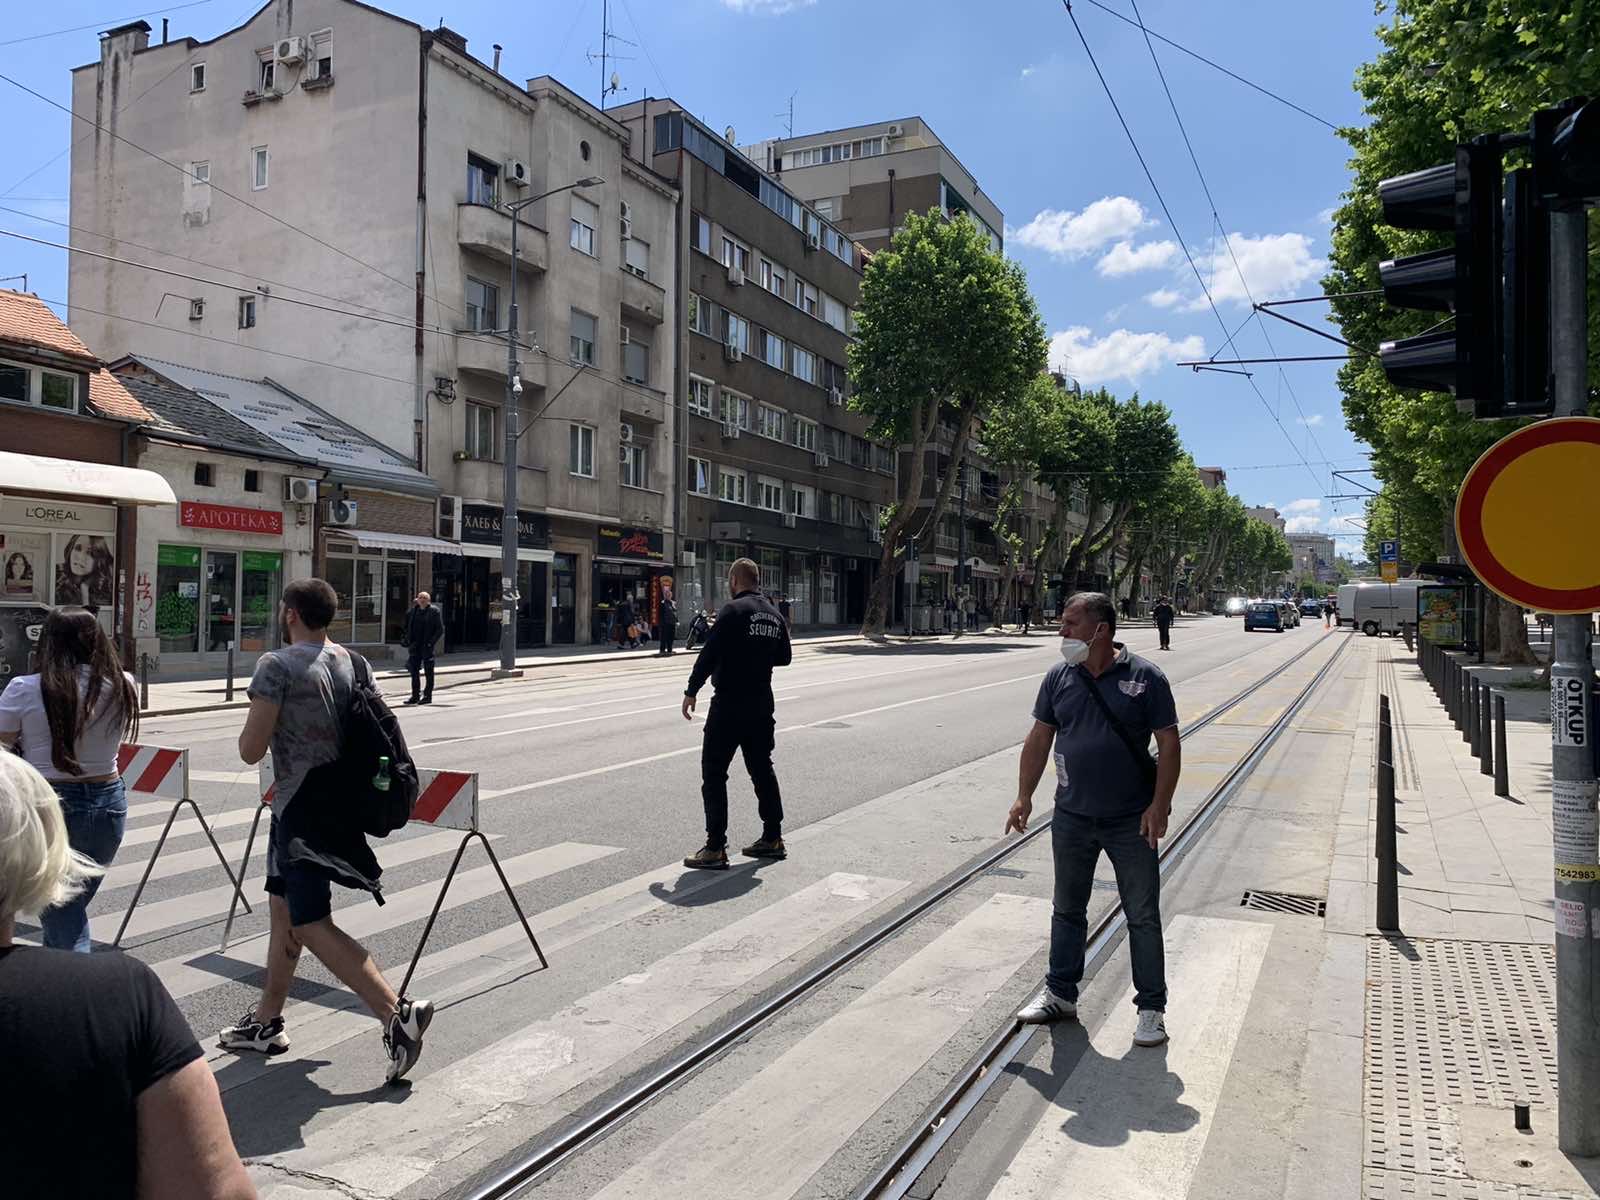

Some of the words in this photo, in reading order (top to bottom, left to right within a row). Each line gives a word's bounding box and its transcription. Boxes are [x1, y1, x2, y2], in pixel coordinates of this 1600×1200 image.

[198, 510, 267, 529] APOTEKA
[464, 515, 490, 529] ХЛЕБ
[1384, 543, 1393, 554] P
[1567, 679, 1585, 745] OTKUP
